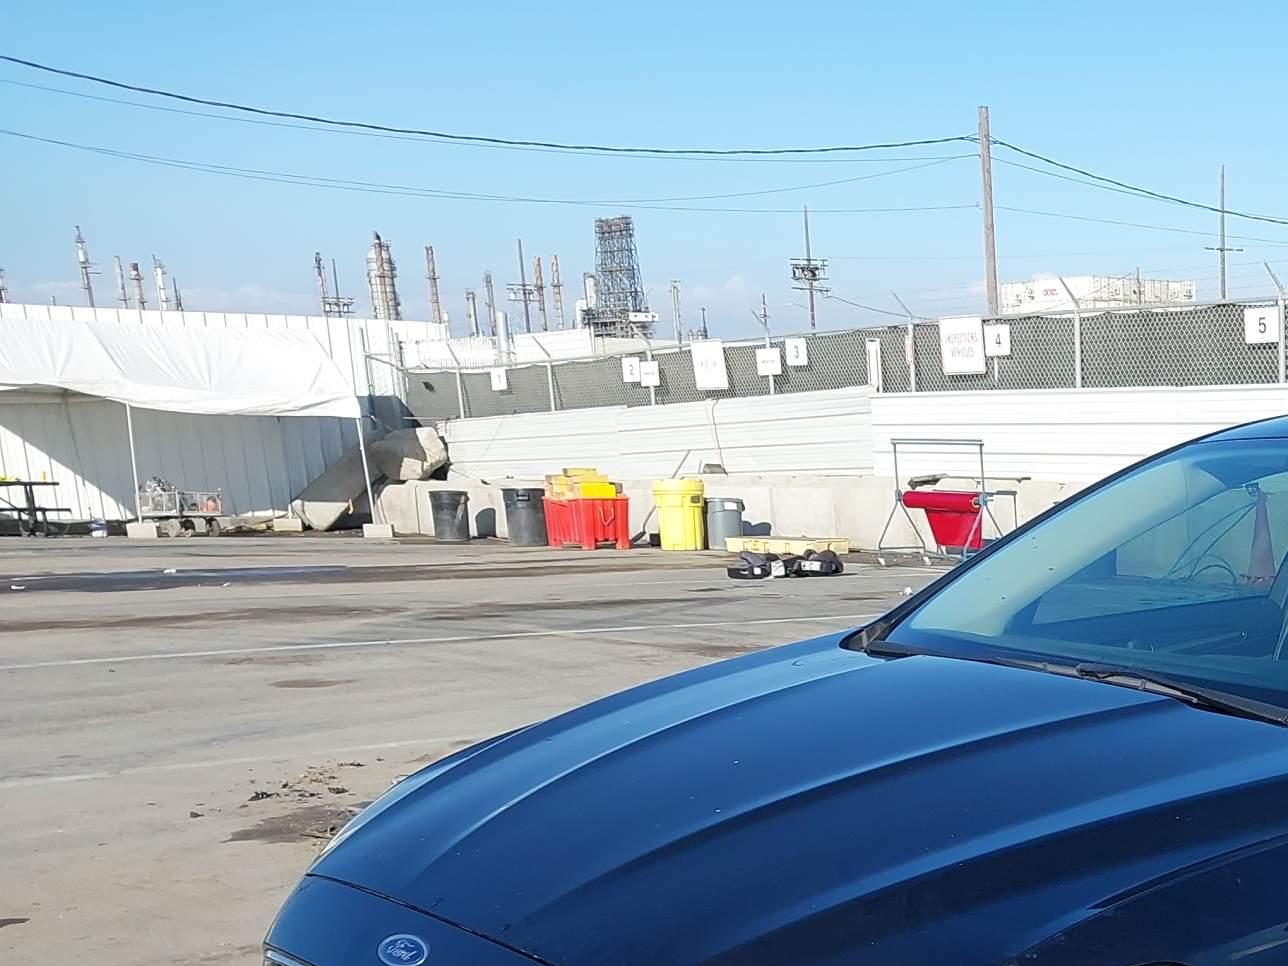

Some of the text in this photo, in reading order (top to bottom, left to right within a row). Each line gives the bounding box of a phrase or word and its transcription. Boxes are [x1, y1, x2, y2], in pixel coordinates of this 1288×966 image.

[1258, 317, 1267, 334] 5
[995, 333, 1002, 347] 4
[793, 345, 800, 359] 3
[629, 364, 636, 376] 2
[386, 939, 417, 961] Ford
